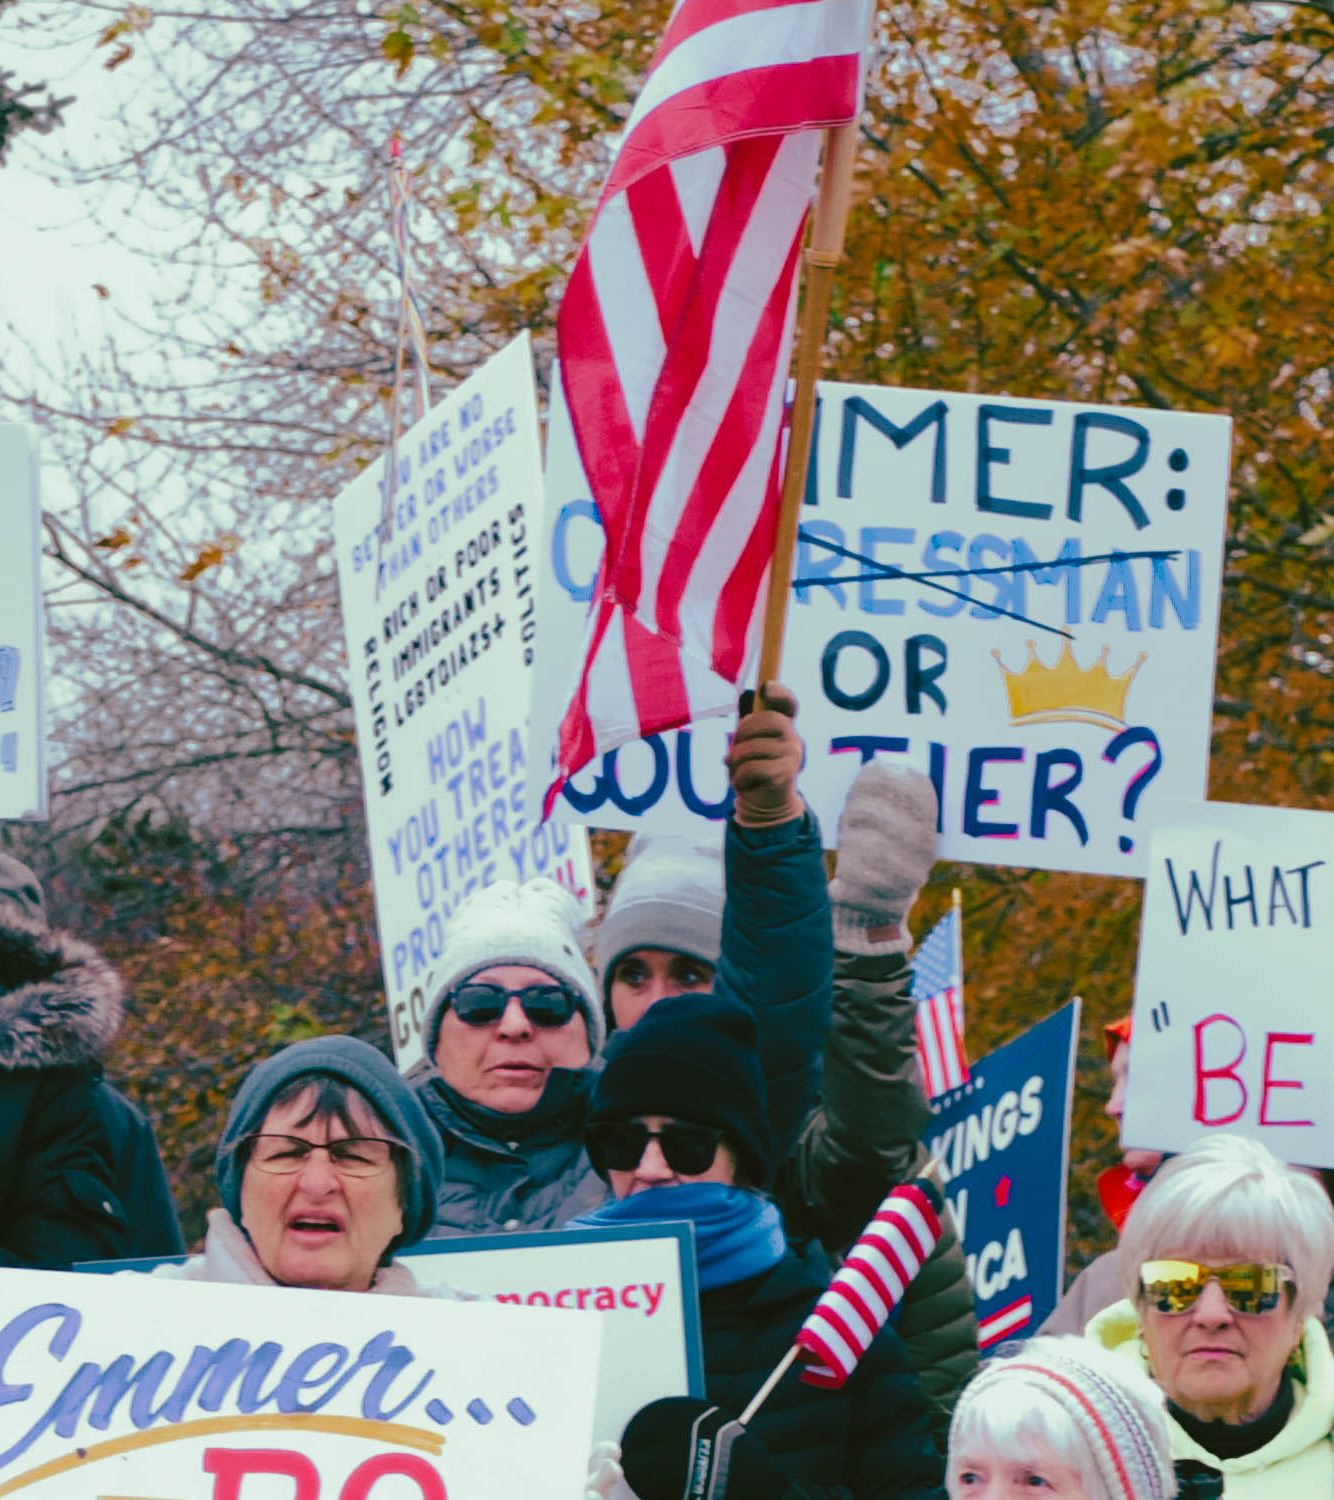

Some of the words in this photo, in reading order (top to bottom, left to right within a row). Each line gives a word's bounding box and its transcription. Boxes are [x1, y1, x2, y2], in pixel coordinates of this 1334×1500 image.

[453, 406, 516, 480] WORSE
[428, 464, 500, 544] OTHERS
[455, 520, 502, 578] POOR
[392, 567, 501, 683] IMMIGRANTS
[821, 629, 948, 715] OR
[427, 695, 487, 785] HOW
[387, 798, 440, 876] YOU
[447, 716, 530, 821] TREA
[1165, 839, 1325, 936] WHAT
